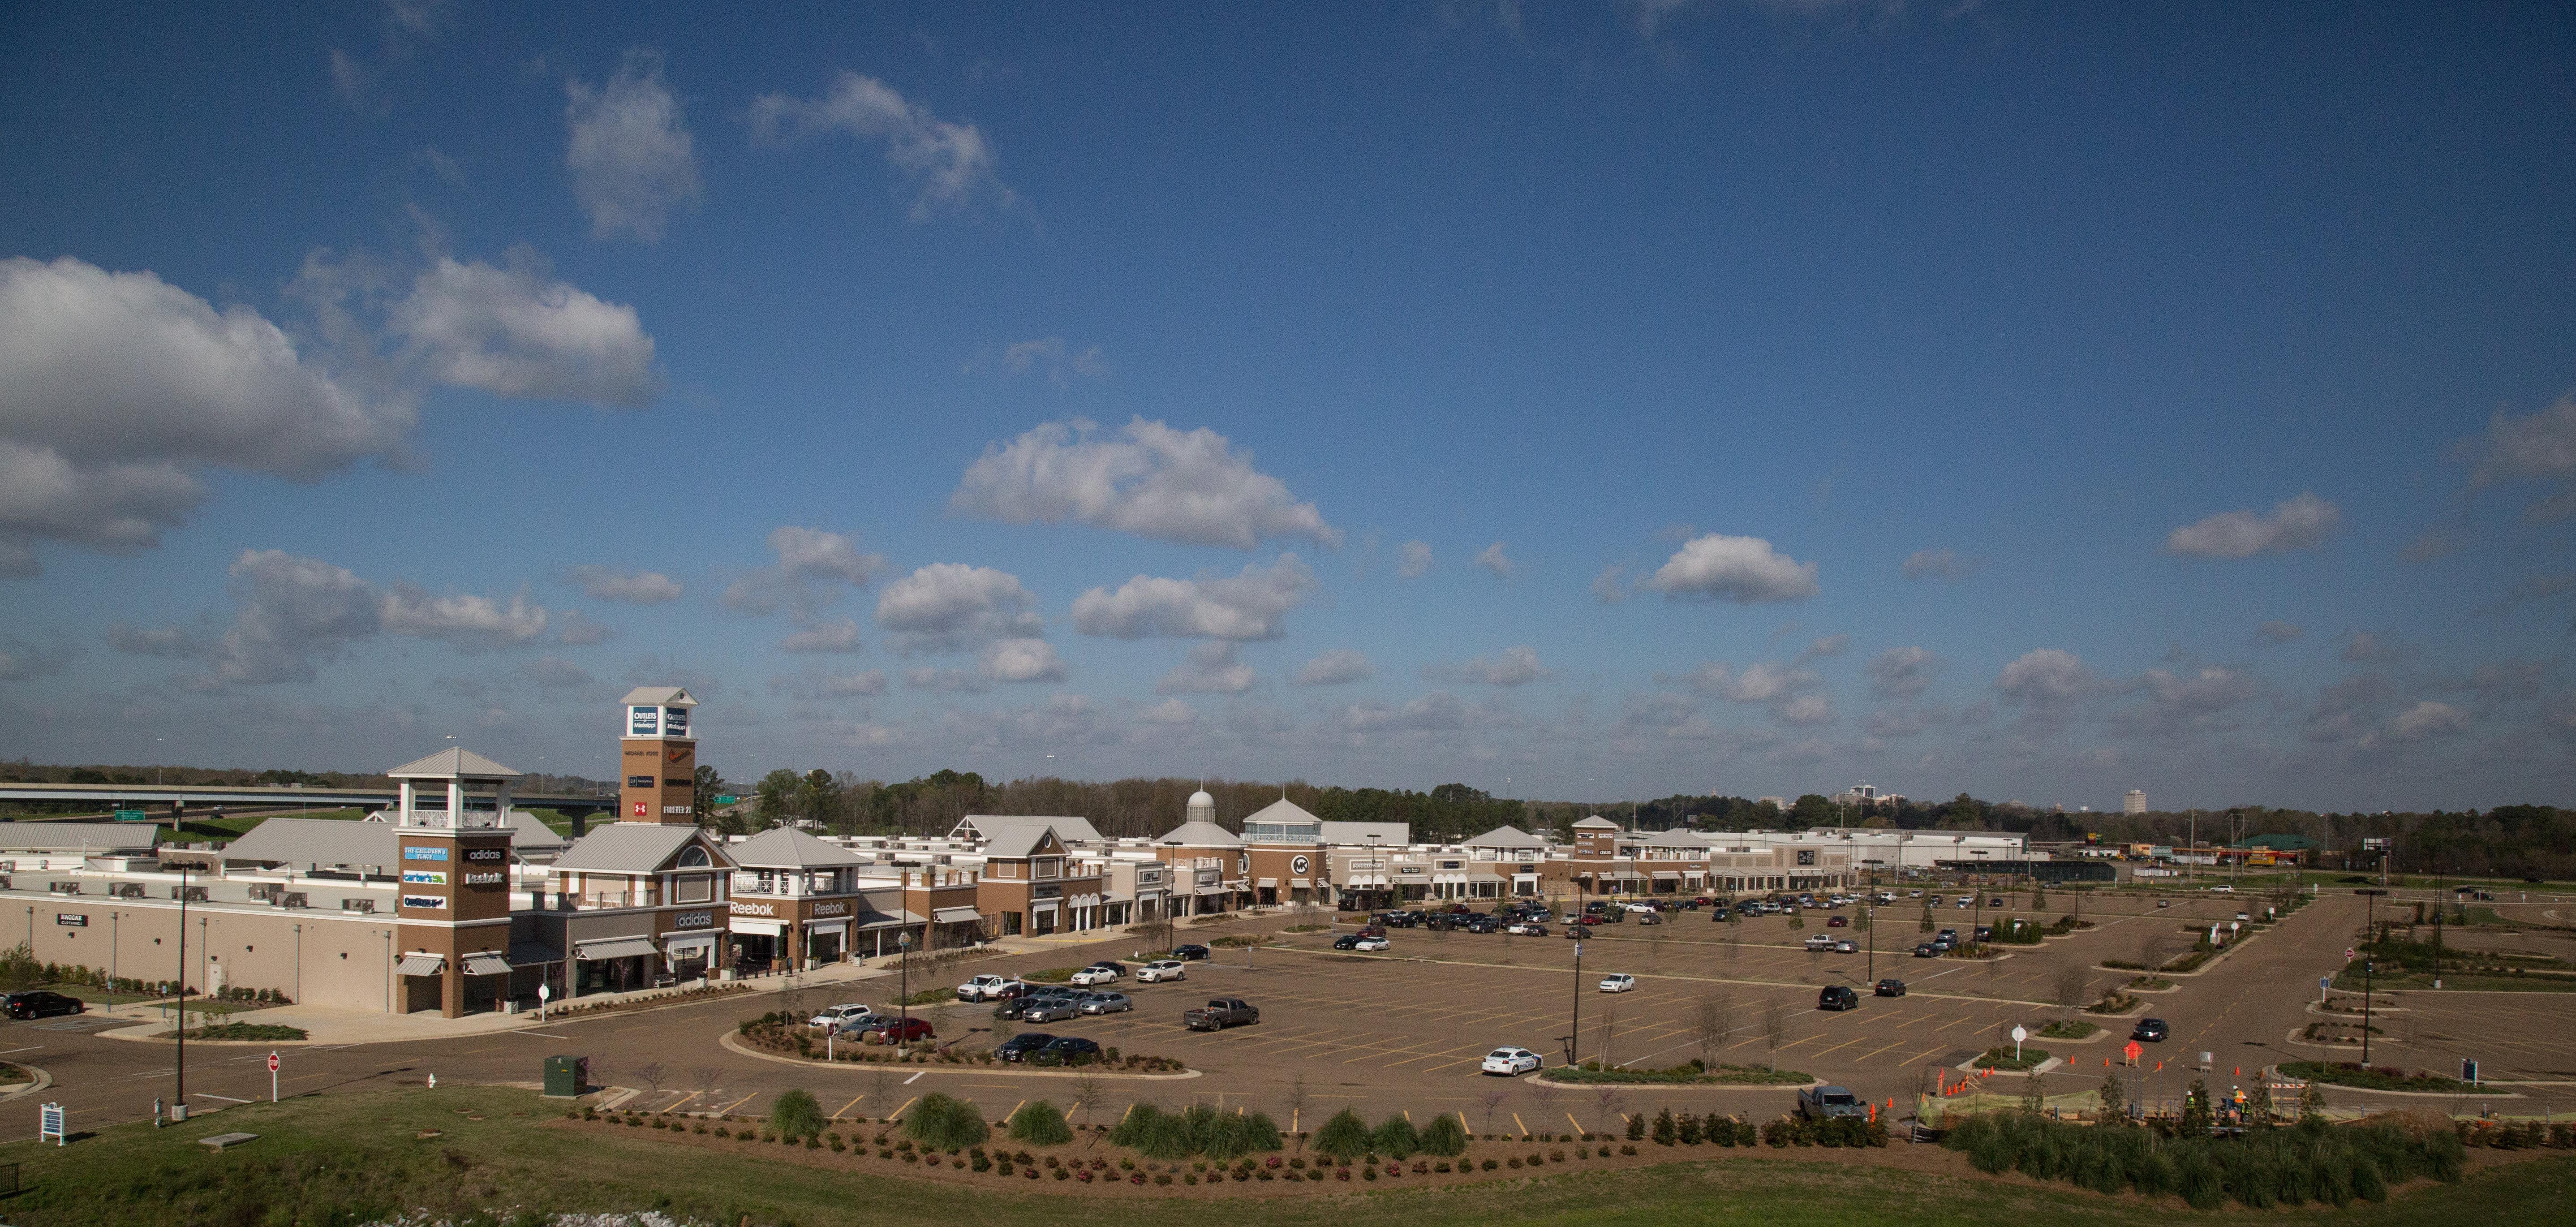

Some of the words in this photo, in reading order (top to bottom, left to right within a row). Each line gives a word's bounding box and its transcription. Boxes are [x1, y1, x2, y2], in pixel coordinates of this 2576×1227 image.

[470, 849, 501, 860] adidas
[465, 872, 503, 884] Reebok
[730, 901, 774, 915] Reebok
[815, 902, 845, 915] Reebok
[679, 913, 711, 927] adidas
